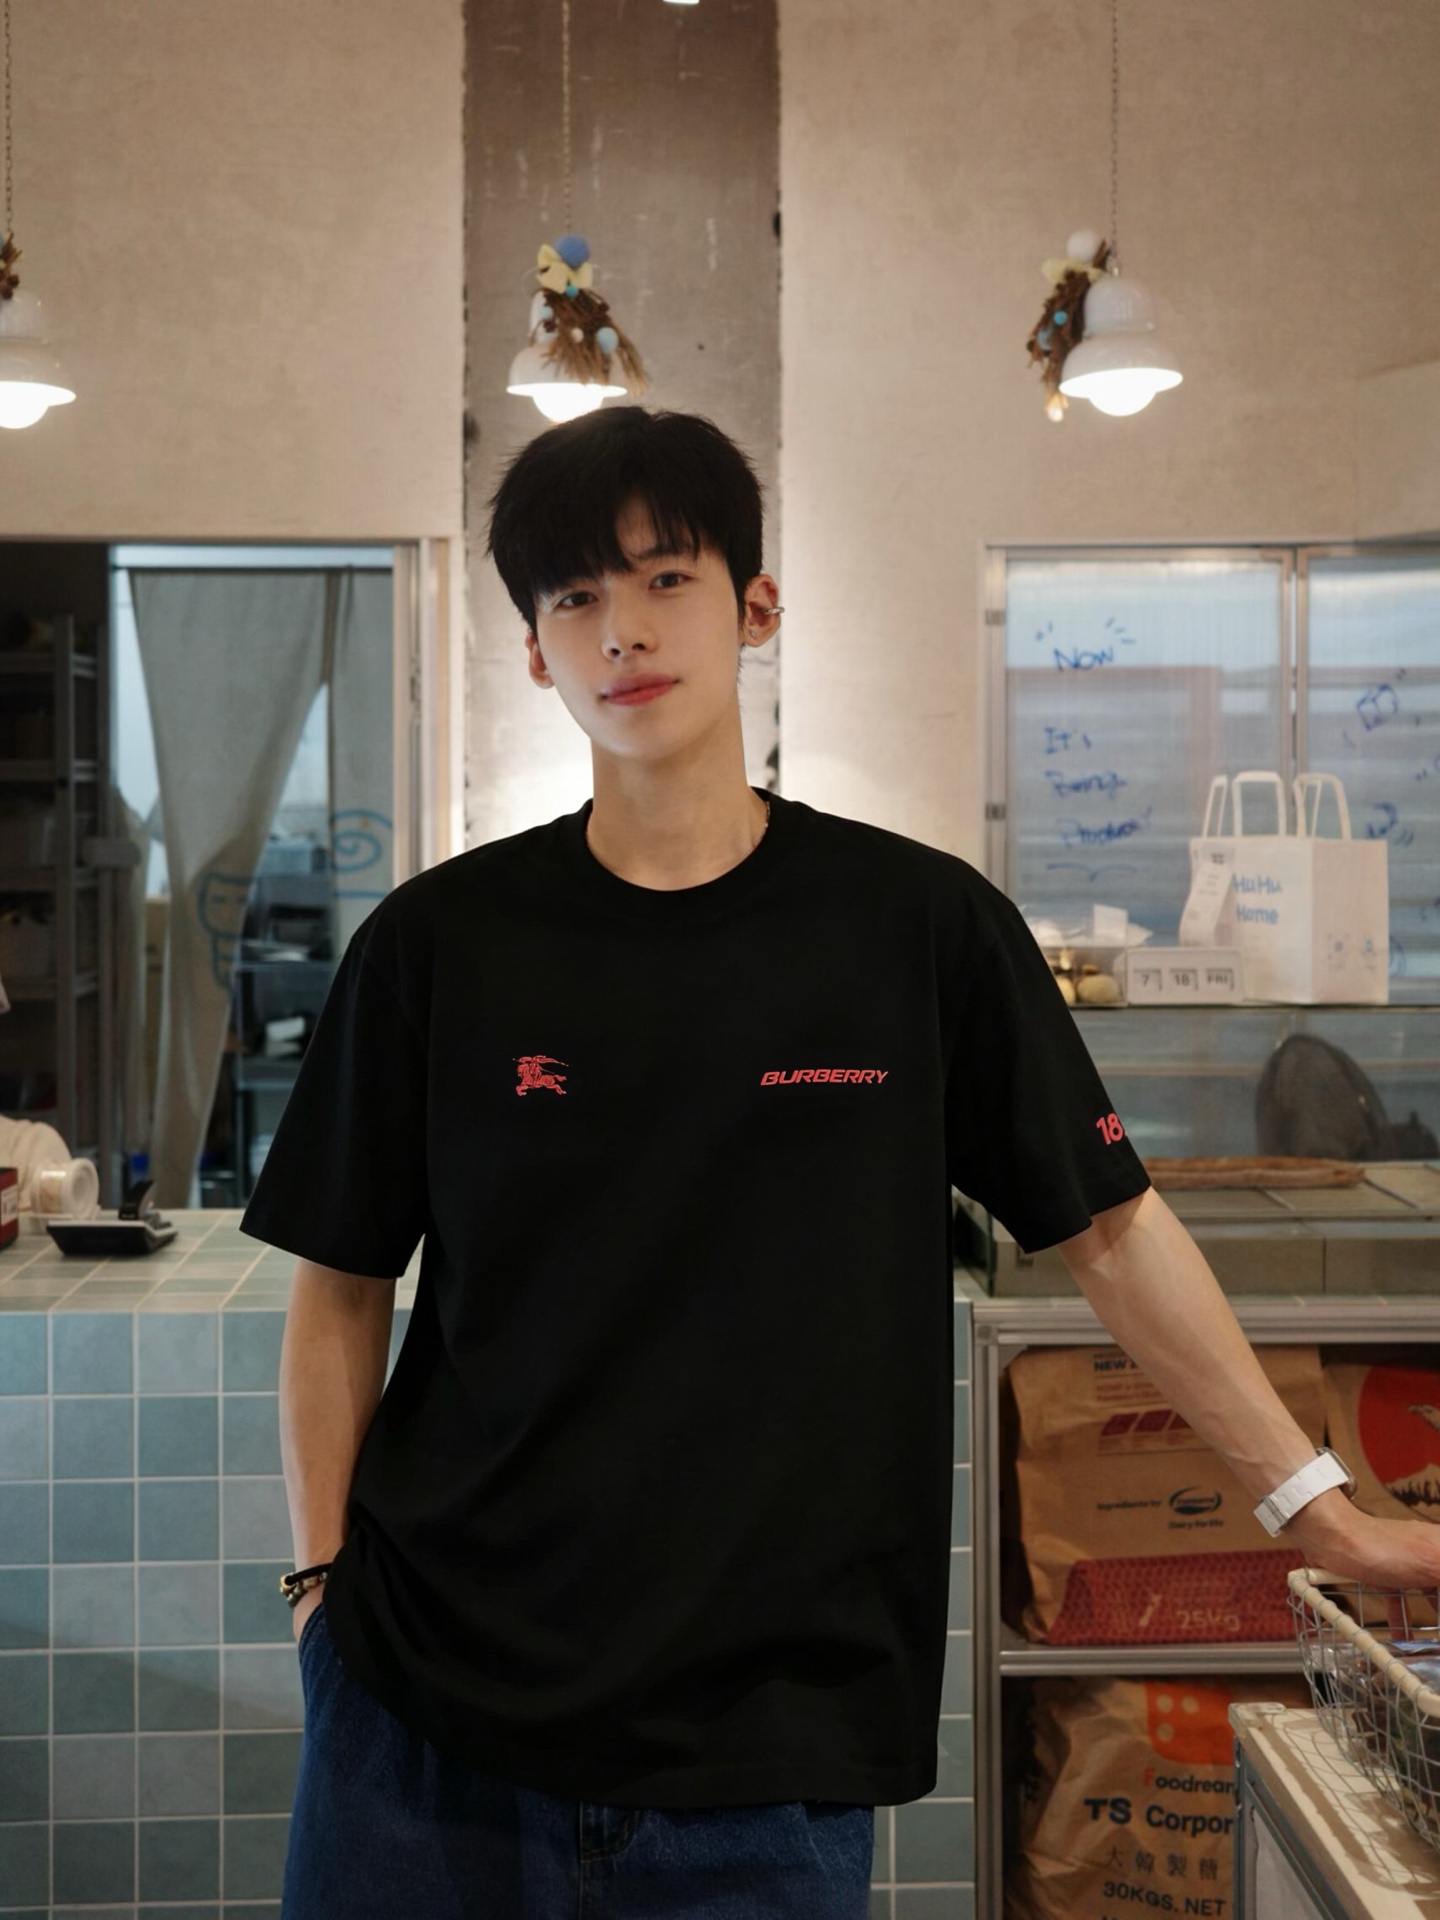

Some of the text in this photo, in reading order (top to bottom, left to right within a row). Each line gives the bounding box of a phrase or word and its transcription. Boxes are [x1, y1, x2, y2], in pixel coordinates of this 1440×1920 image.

[1053, 645, 1114, 671] Now
[1236, 904, 1279, 926] Home
[1141, 974, 1151, 987] 7
[760, 1069, 889, 1086] BURBERRY
[1096, 1112, 1128, 1145] 18
[1085, 1796, 1234, 1838] TS Corpor
[1184, 1897, 1227, 1917] NET
